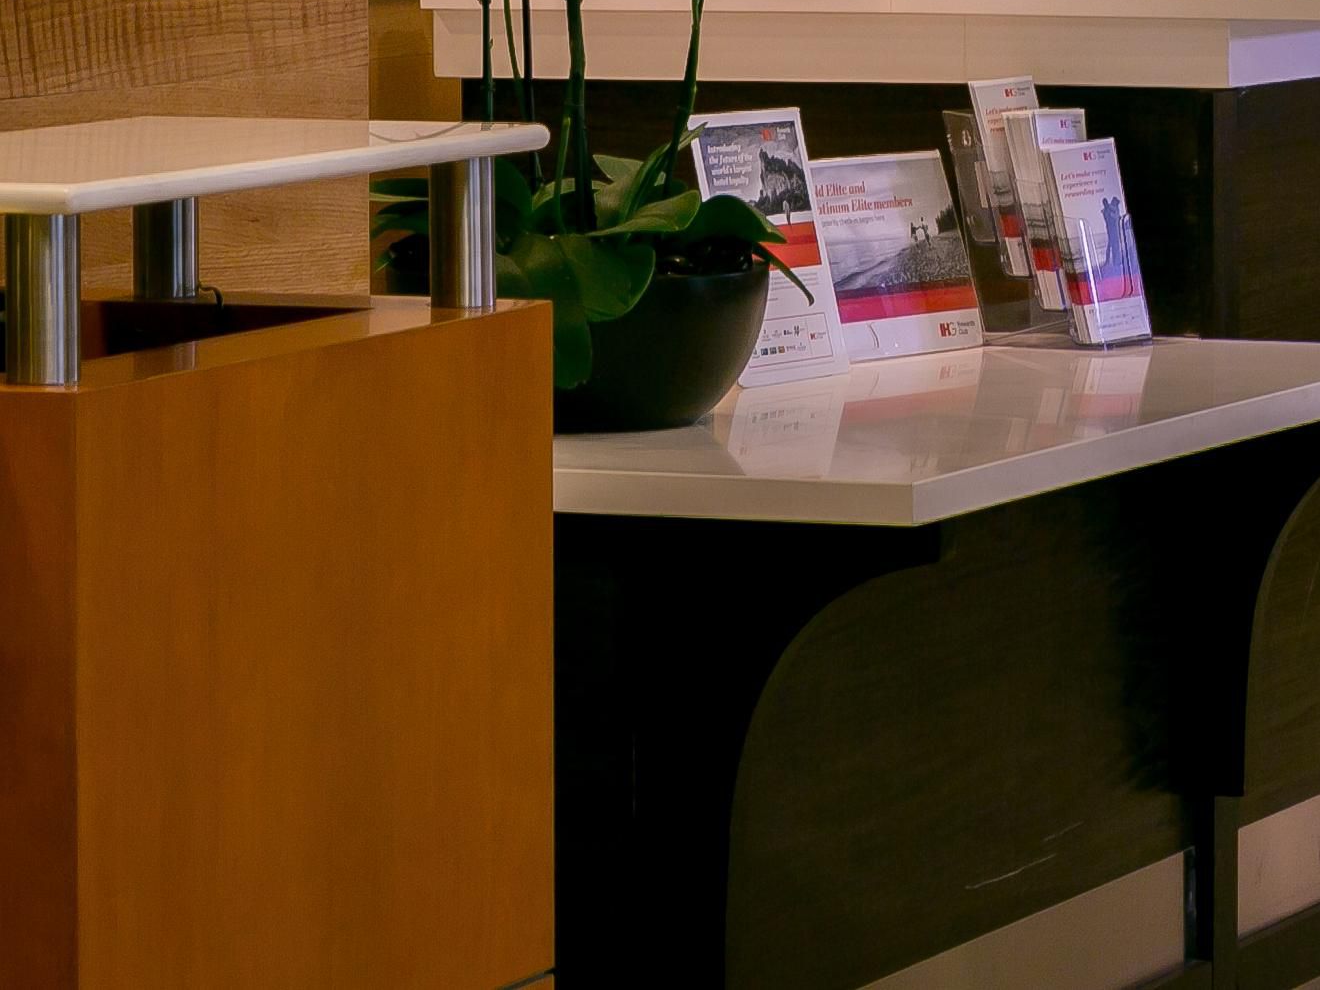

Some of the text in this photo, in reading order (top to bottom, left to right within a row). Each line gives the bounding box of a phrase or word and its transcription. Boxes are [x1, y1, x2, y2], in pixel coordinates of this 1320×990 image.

[826, 182, 848, 197] Elite
[849, 180, 866, 195] and
[851, 198, 873, 213] Elite
[874, 195, 913, 211] members
[939, 321, 957, 337] IHG
